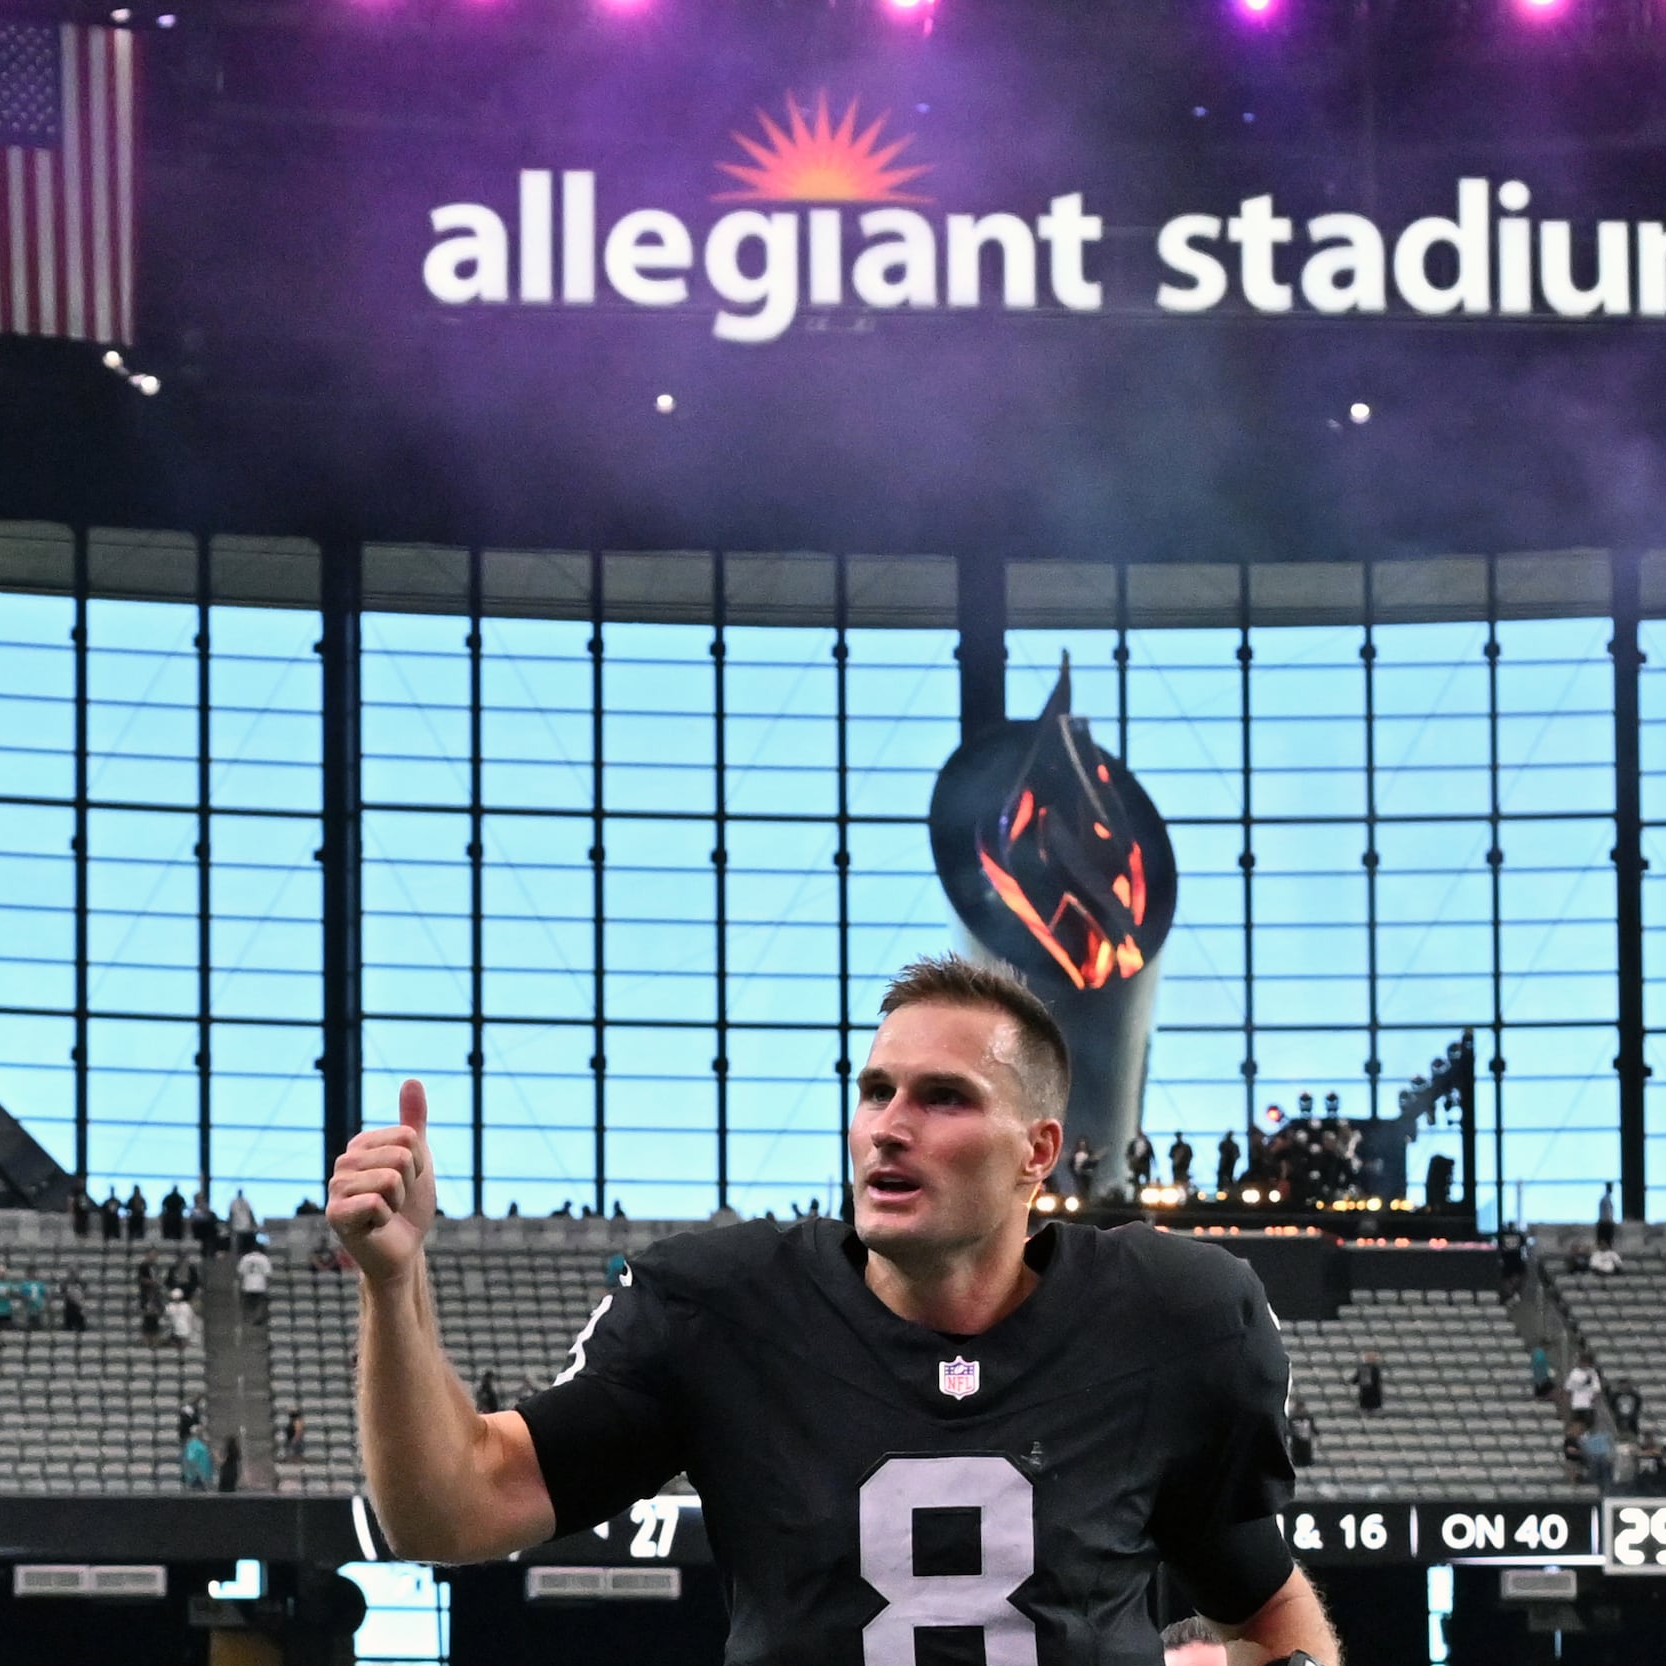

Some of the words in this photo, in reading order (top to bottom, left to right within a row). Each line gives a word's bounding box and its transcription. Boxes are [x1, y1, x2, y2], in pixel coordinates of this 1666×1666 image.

[422, 170, 1102, 342] allegiant
[948, 1376, 972, 1392] NFL
[630, 1499, 680, 1558] 27
[1293, 1513, 1324, 1550] &
[1339, 1513, 1388, 1550] 16
[1441, 1513, 1505, 1550] ON
[1514, 1513, 1569, 1550] 40
